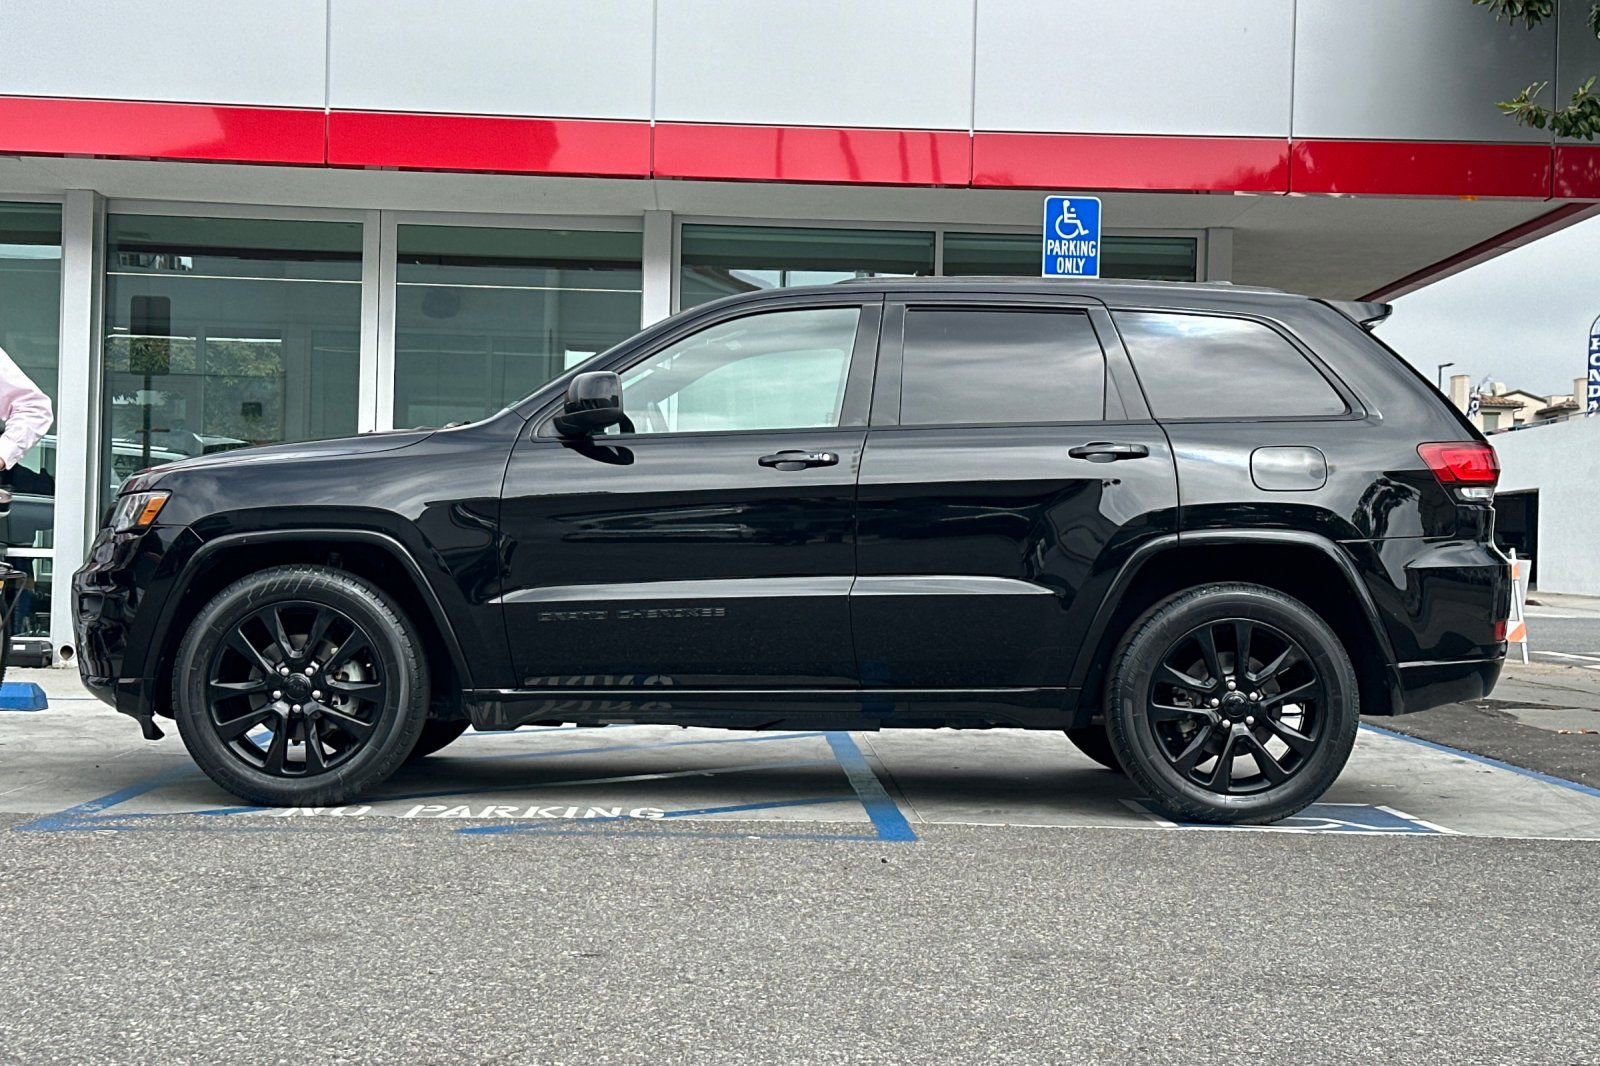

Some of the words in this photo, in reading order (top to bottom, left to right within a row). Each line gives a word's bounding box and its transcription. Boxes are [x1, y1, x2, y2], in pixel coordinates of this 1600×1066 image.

[1046, 239, 1096, 257] PARKING
[1056, 257, 1086, 274] ONLY
[402, 804, 665, 819] PARKING
